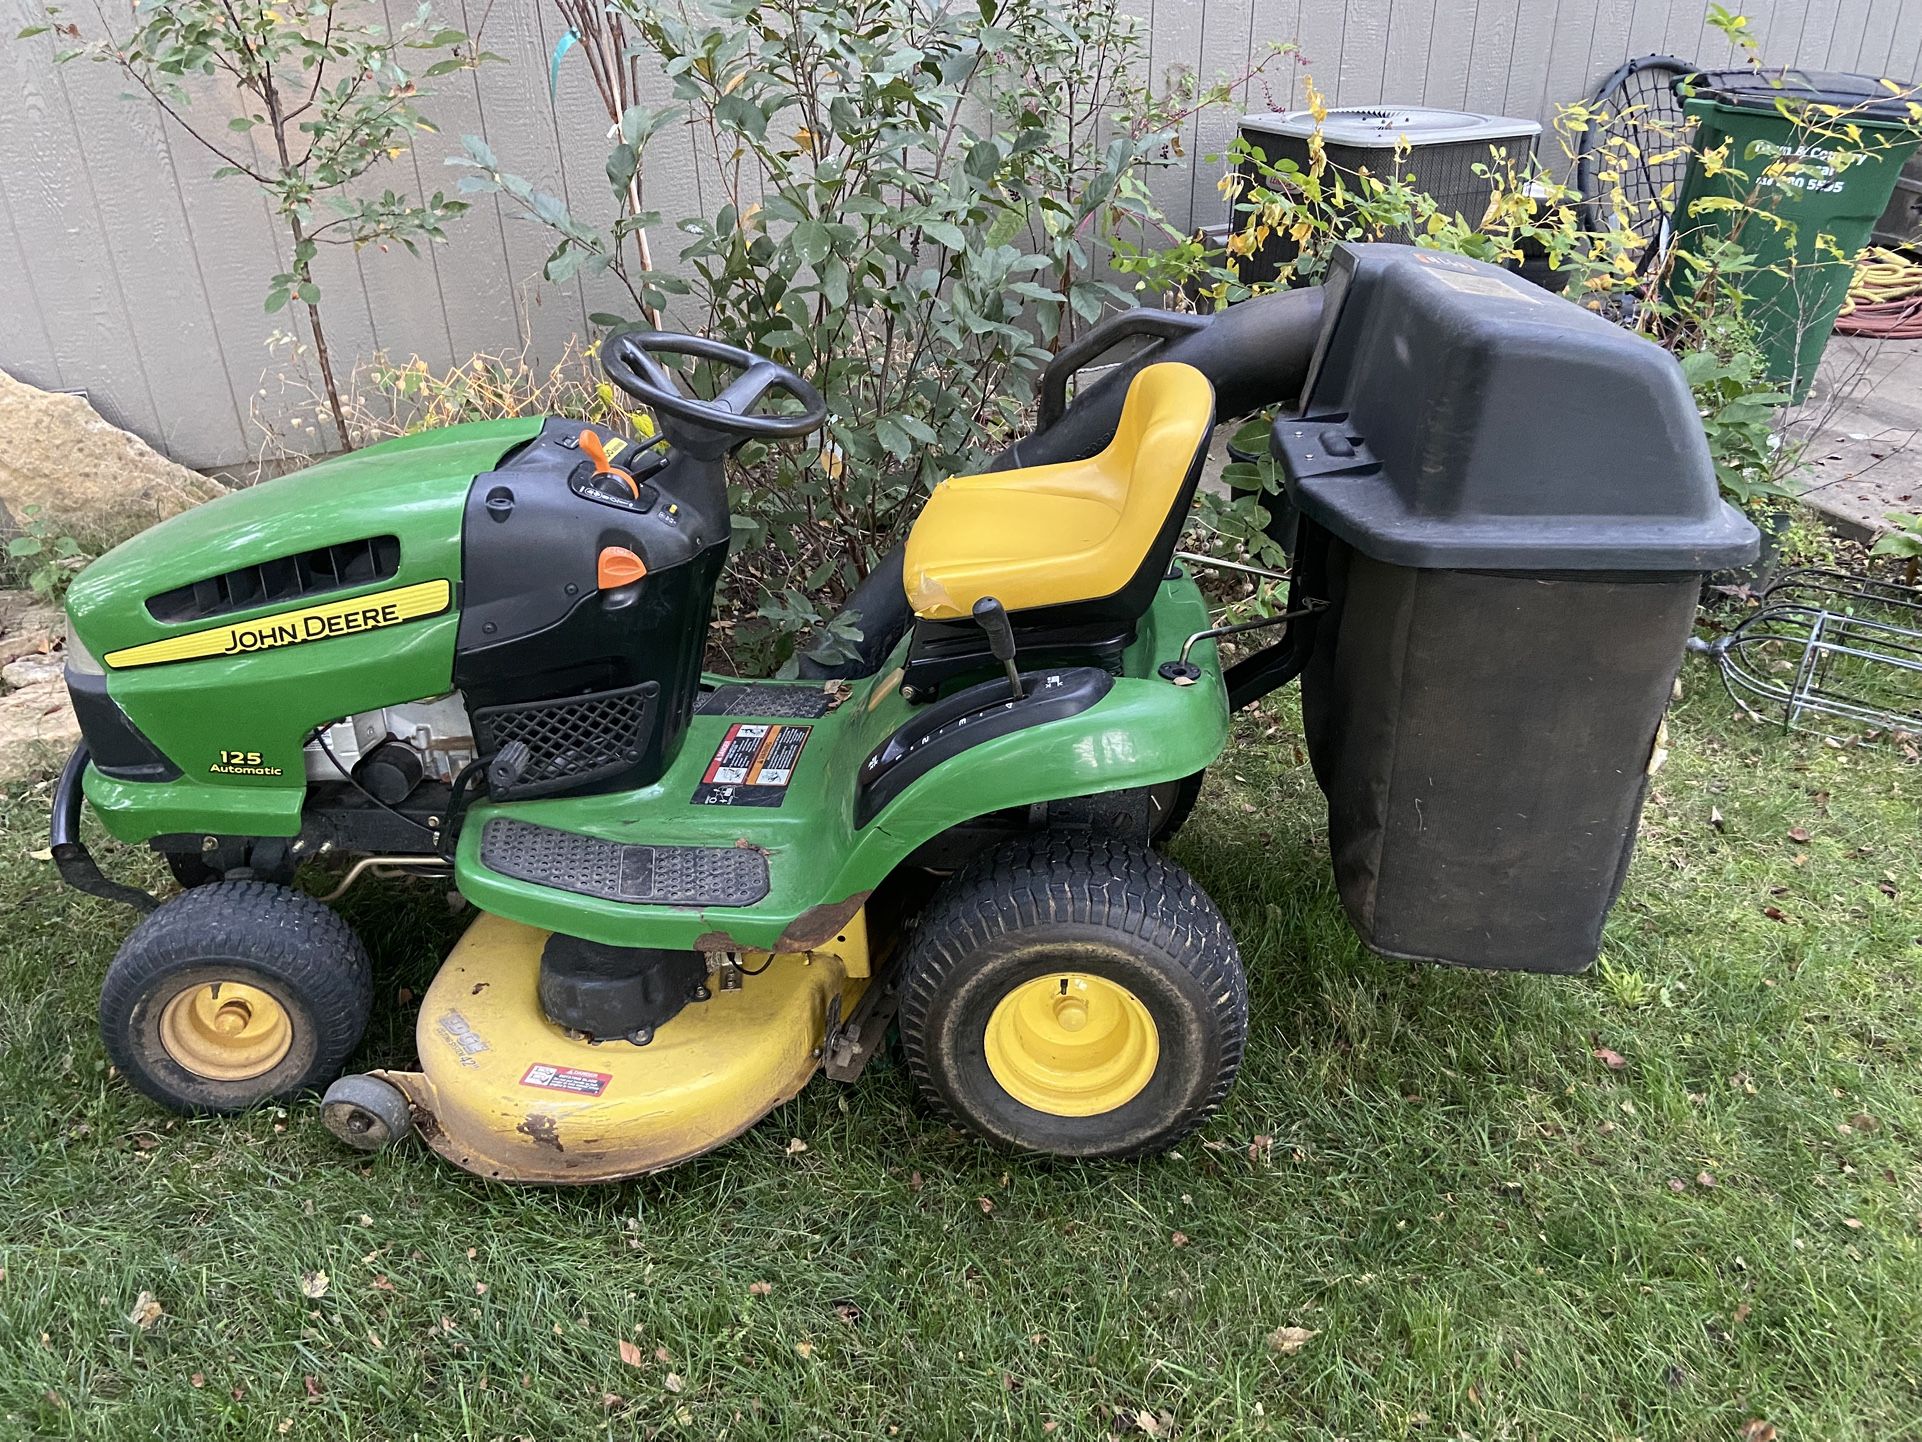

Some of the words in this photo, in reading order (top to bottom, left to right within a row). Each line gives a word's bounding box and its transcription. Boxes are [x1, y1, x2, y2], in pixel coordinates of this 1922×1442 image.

[224, 623, 298, 652] JOHN
[303, 604, 400, 638] DEERE
[220, 750, 262, 765] 125
[209, 763, 282, 776] Automatic
